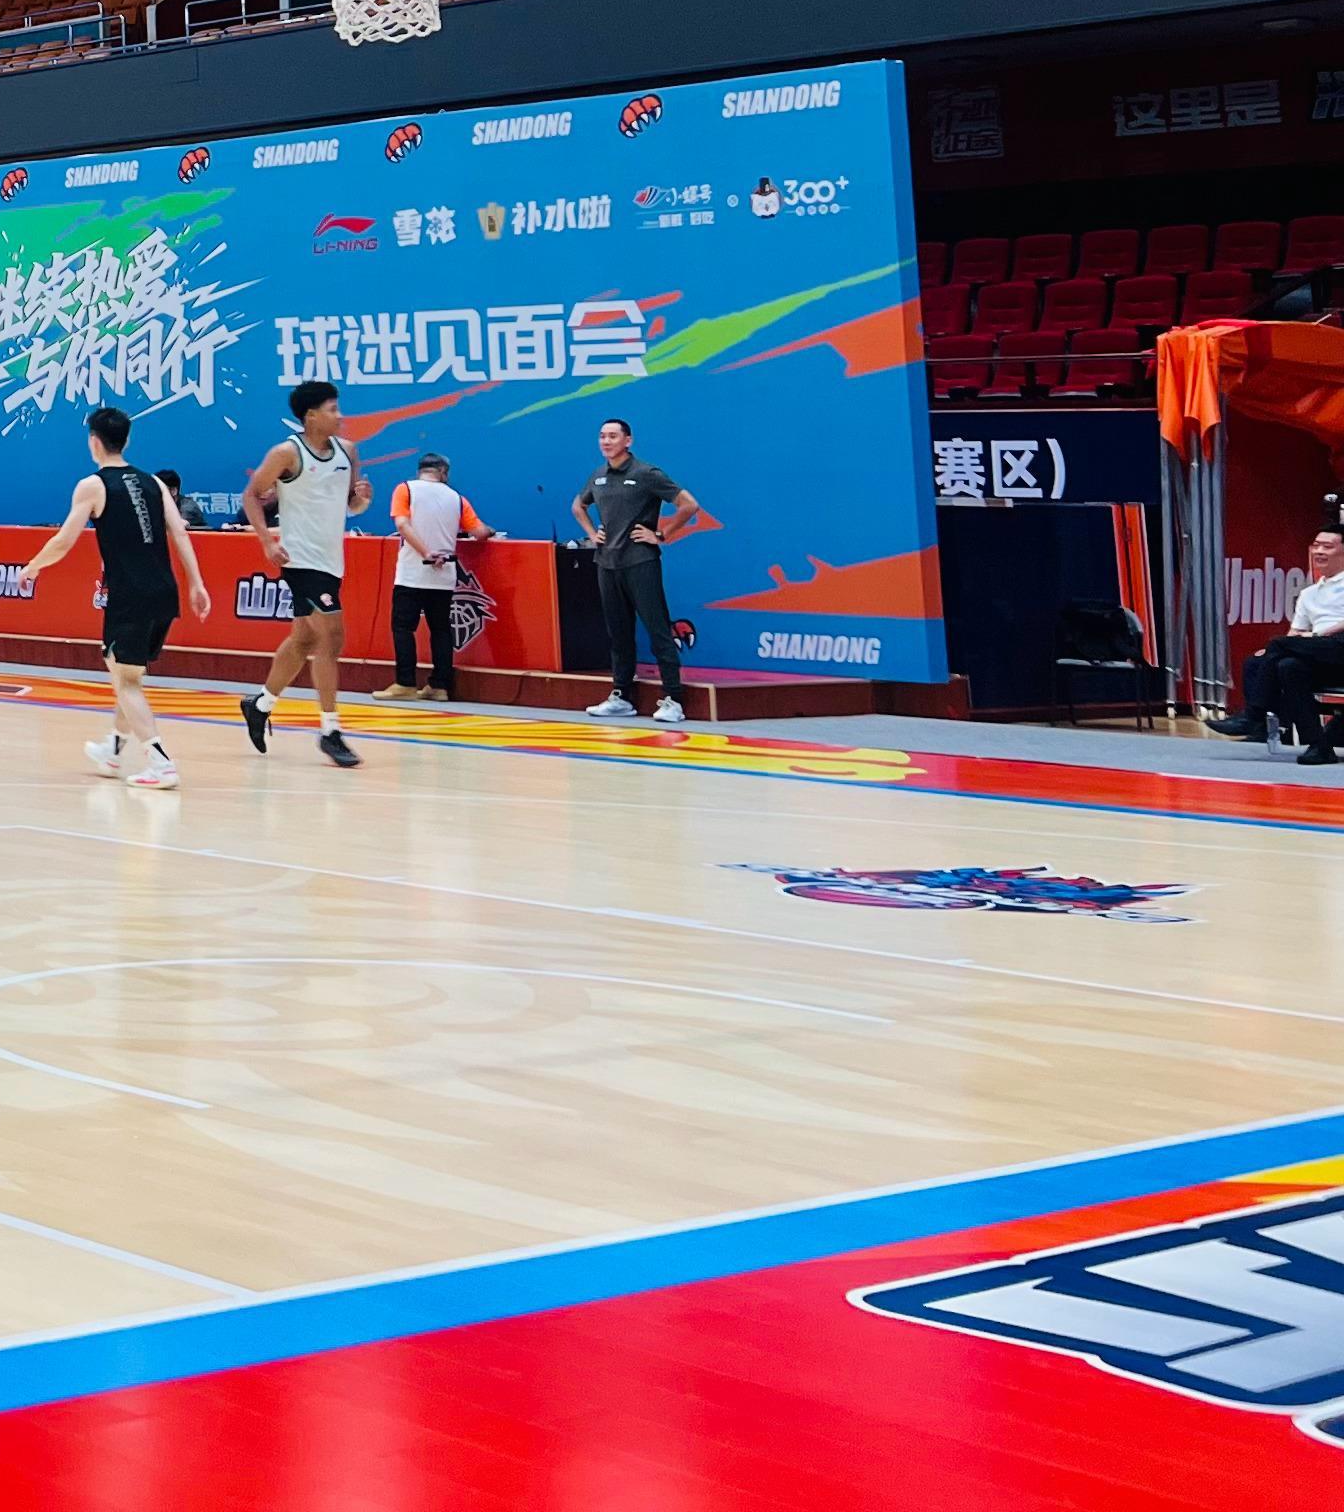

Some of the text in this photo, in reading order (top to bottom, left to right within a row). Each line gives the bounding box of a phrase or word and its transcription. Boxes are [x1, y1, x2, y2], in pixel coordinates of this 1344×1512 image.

[65, 160, 139, 187] SHANDONG
[253, 138, 339, 169] SHANDONG
[472, 112, 572, 145] SHANDONG
[722, 81, 841, 118] SHANDONG
[1112, 80, 1282, 136] 这里是
[393, 205, 457, 247] 雪花
[512, 194, 611, 235] 补水啦
[313, 238, 378, 254] LI-NING
[4, 310, 227, 413] 与你同行
[276, 299, 649, 387] 球迷见面会
[933, 438, 1066, 500] 赛区)
[757, 631, 880, 665] SHANDONG
